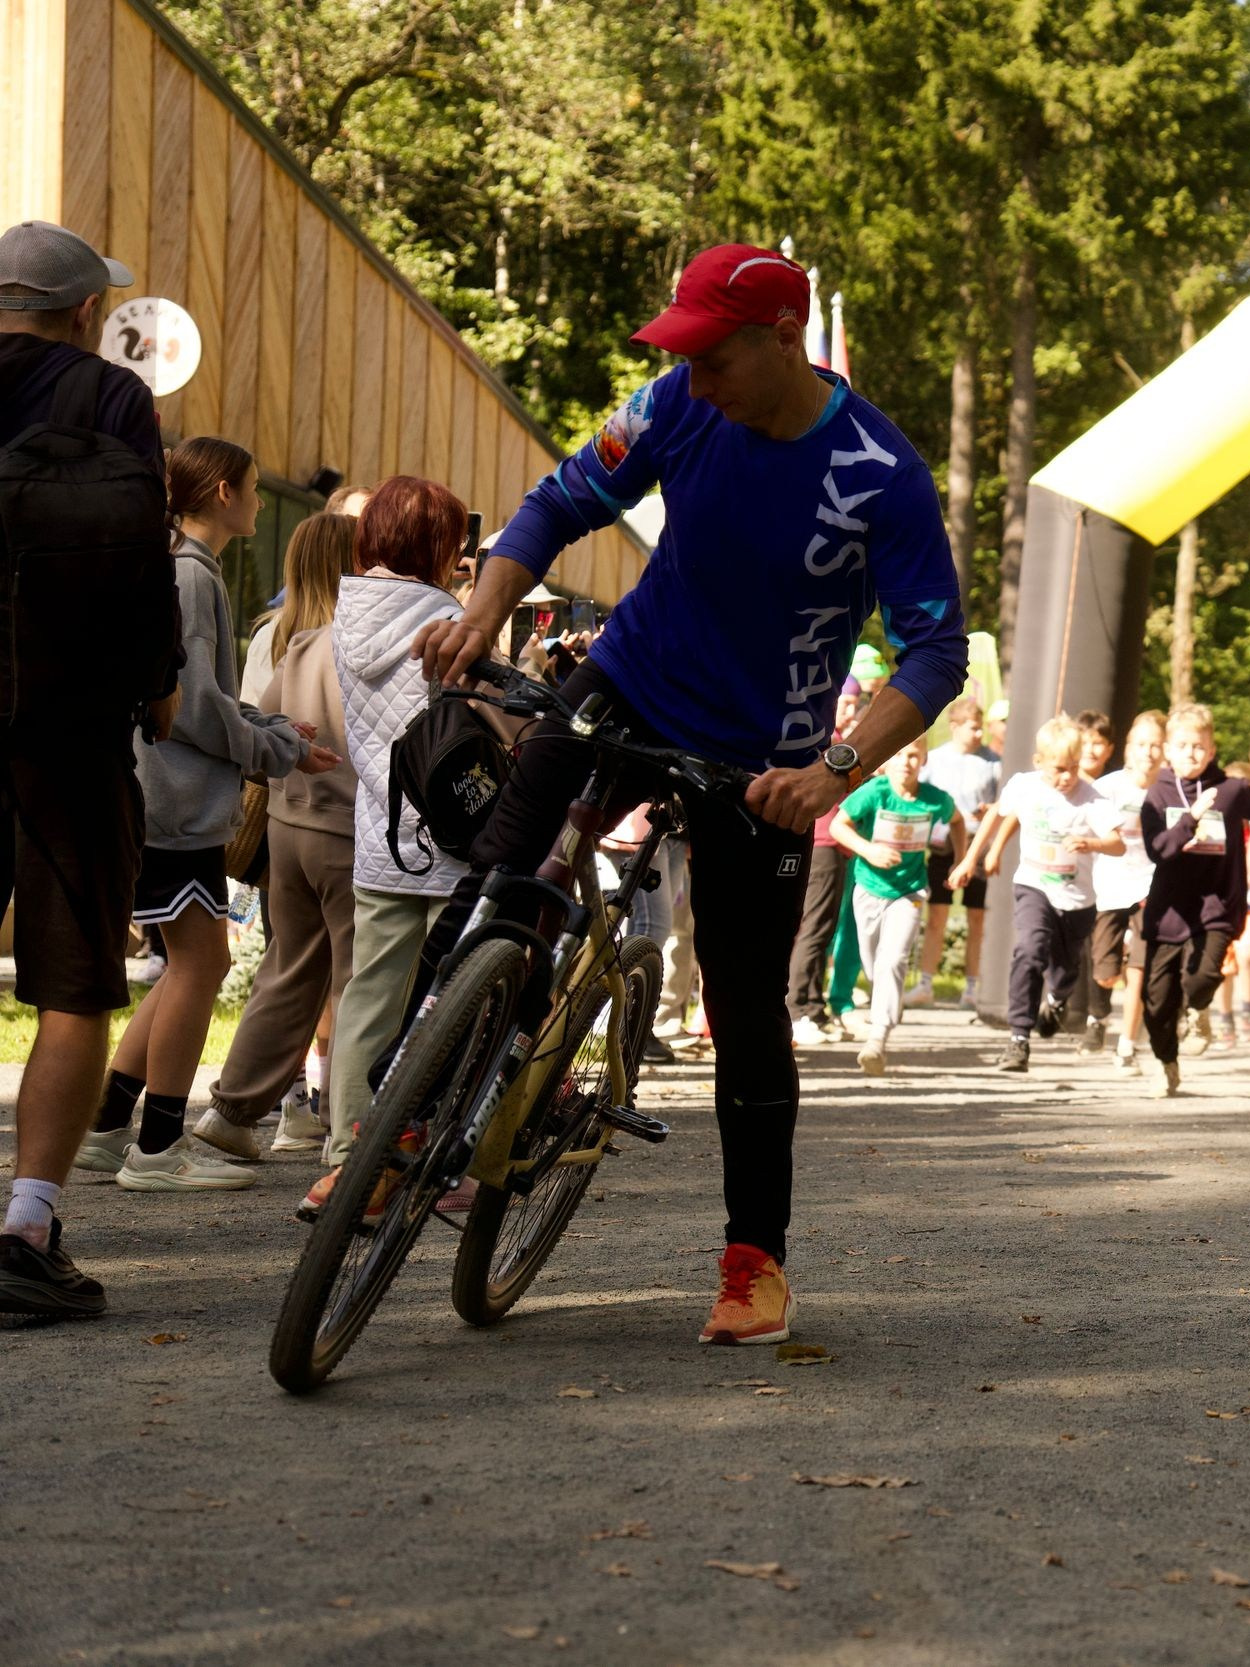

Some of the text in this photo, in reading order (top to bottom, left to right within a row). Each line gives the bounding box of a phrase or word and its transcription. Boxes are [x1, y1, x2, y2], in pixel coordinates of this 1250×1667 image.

[804, 412, 898, 578] SKY
[452, 774, 475, 796] love
[466, 785, 477, 799] to
[468, 787, 496, 815] dance
